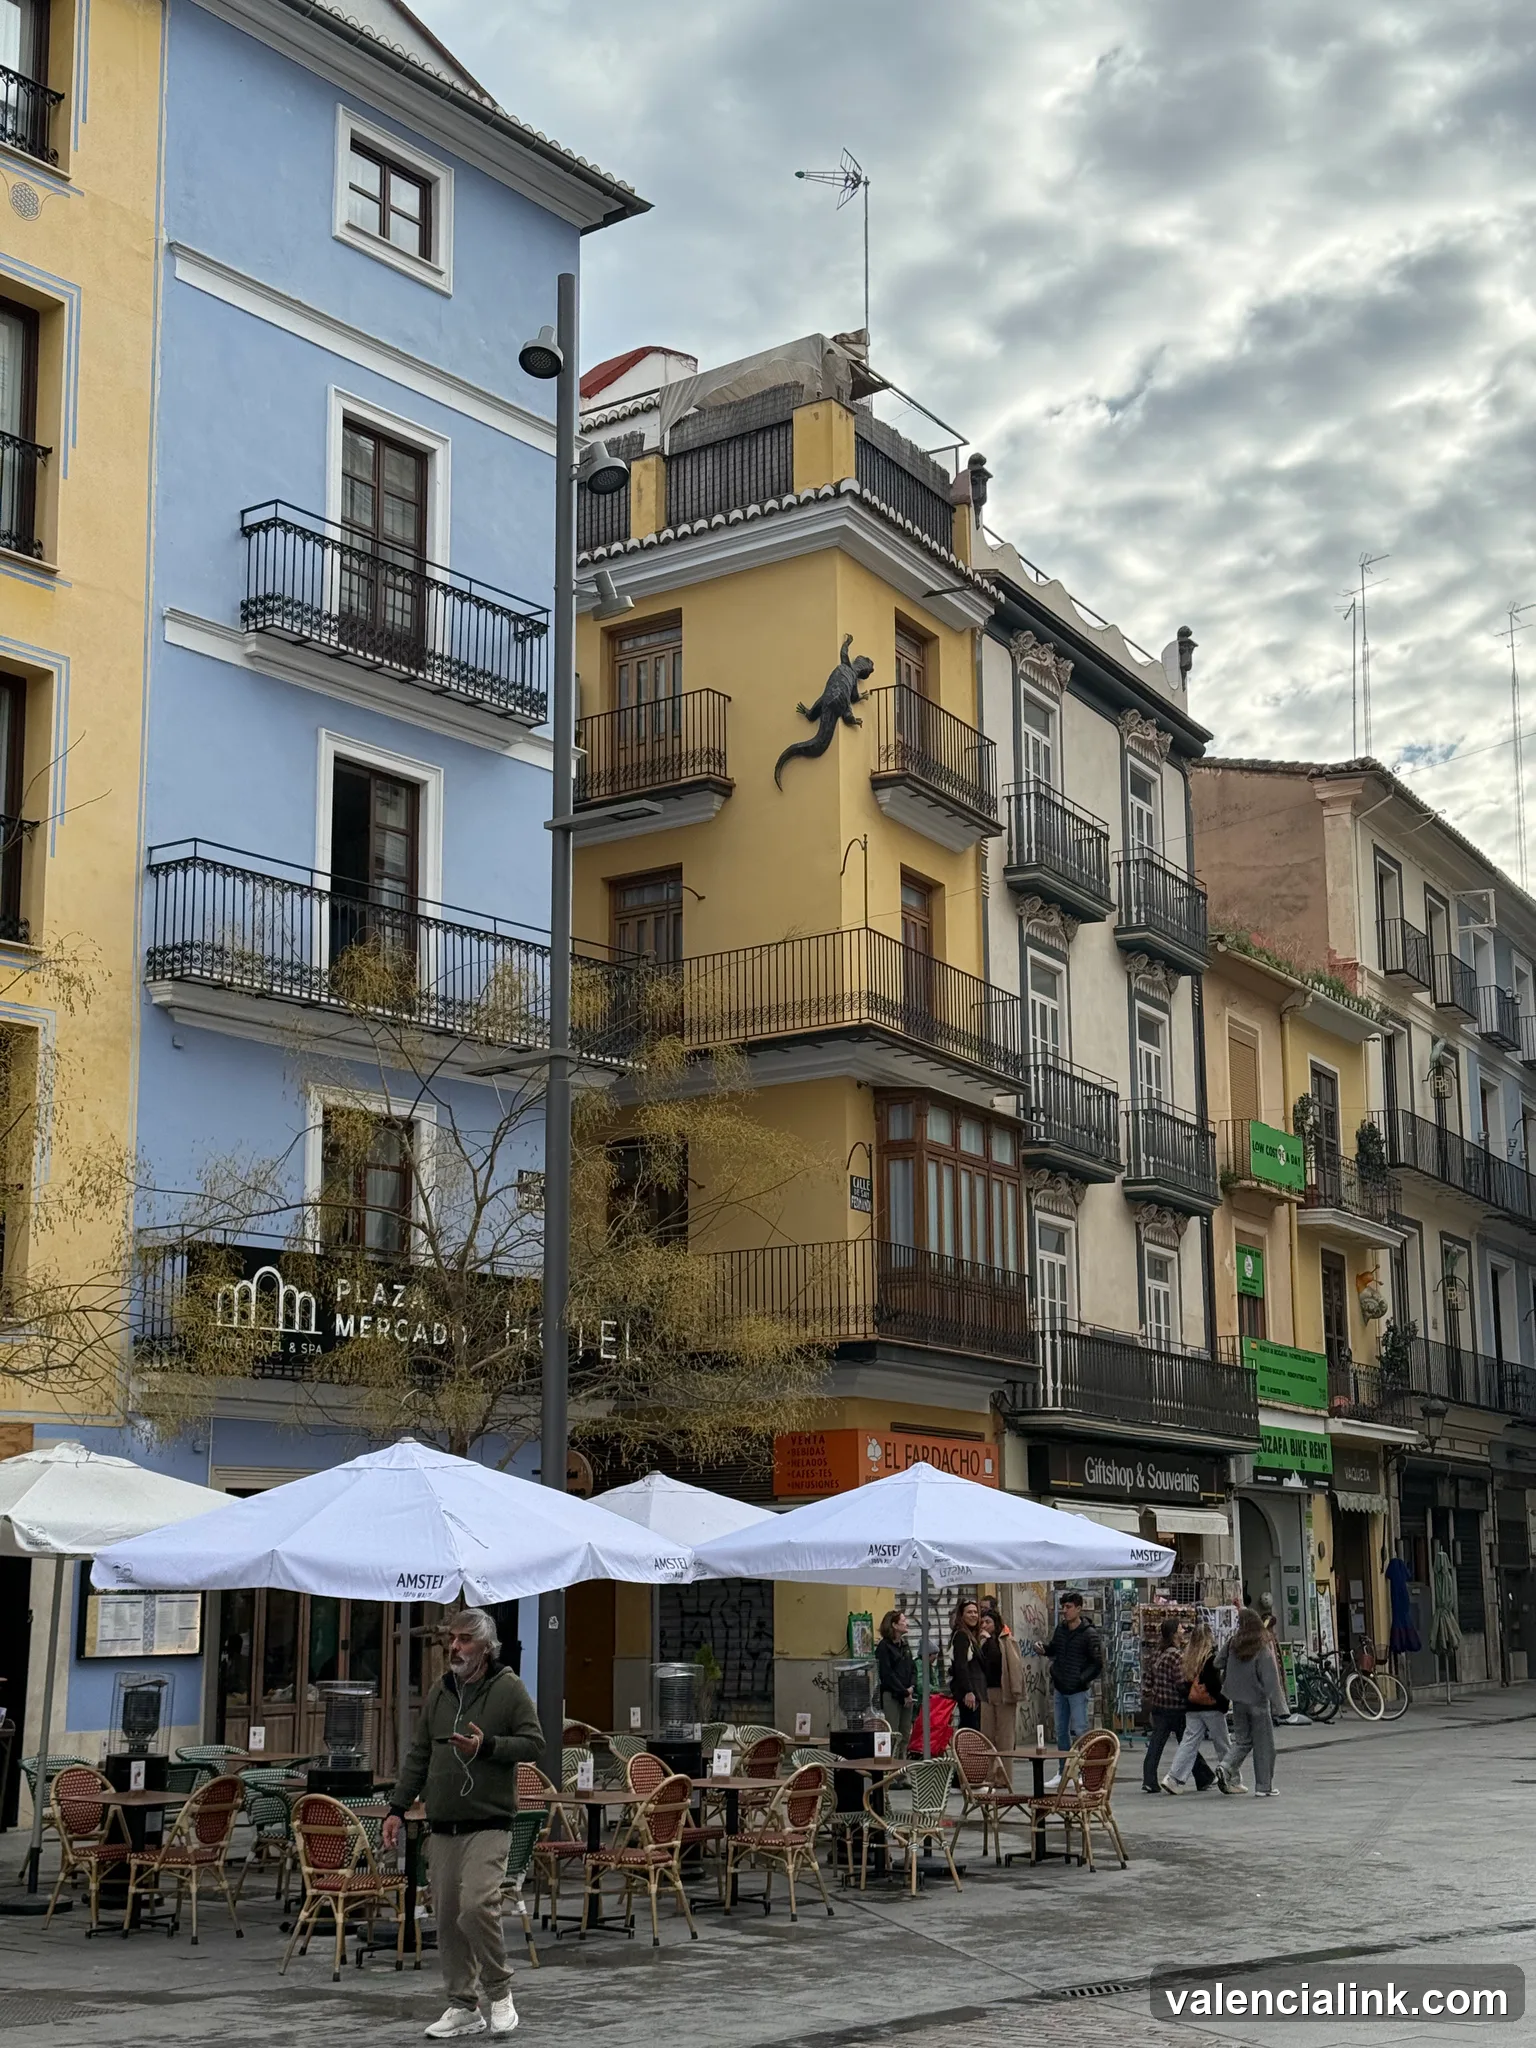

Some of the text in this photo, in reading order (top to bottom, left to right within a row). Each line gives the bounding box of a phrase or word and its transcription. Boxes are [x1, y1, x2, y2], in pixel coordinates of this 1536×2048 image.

[1266, 1144, 1278, 1159] COST
[853, 1177, 870, 1191] CALLE
[288, 1342, 296, 1353] &
[301, 1343, 323, 1354] SPA
[791, 1434, 826, 1446] VENTA
[791, 1447, 826, 1457] BEBIDAS
[1290, 1438, 1307, 1458] BIKE
[1309, 1441, 1328, 1460] RENT
[791, 1458, 828, 1468] HELADOS
[884, 1441, 980, 1476] EL FARDACHO
[1084, 1456, 1200, 1493] Giftshop & Souvenirs
[791, 1480, 840, 1489] INFUSIONES
[654, 1557, 689, 1571] AMSTEL
